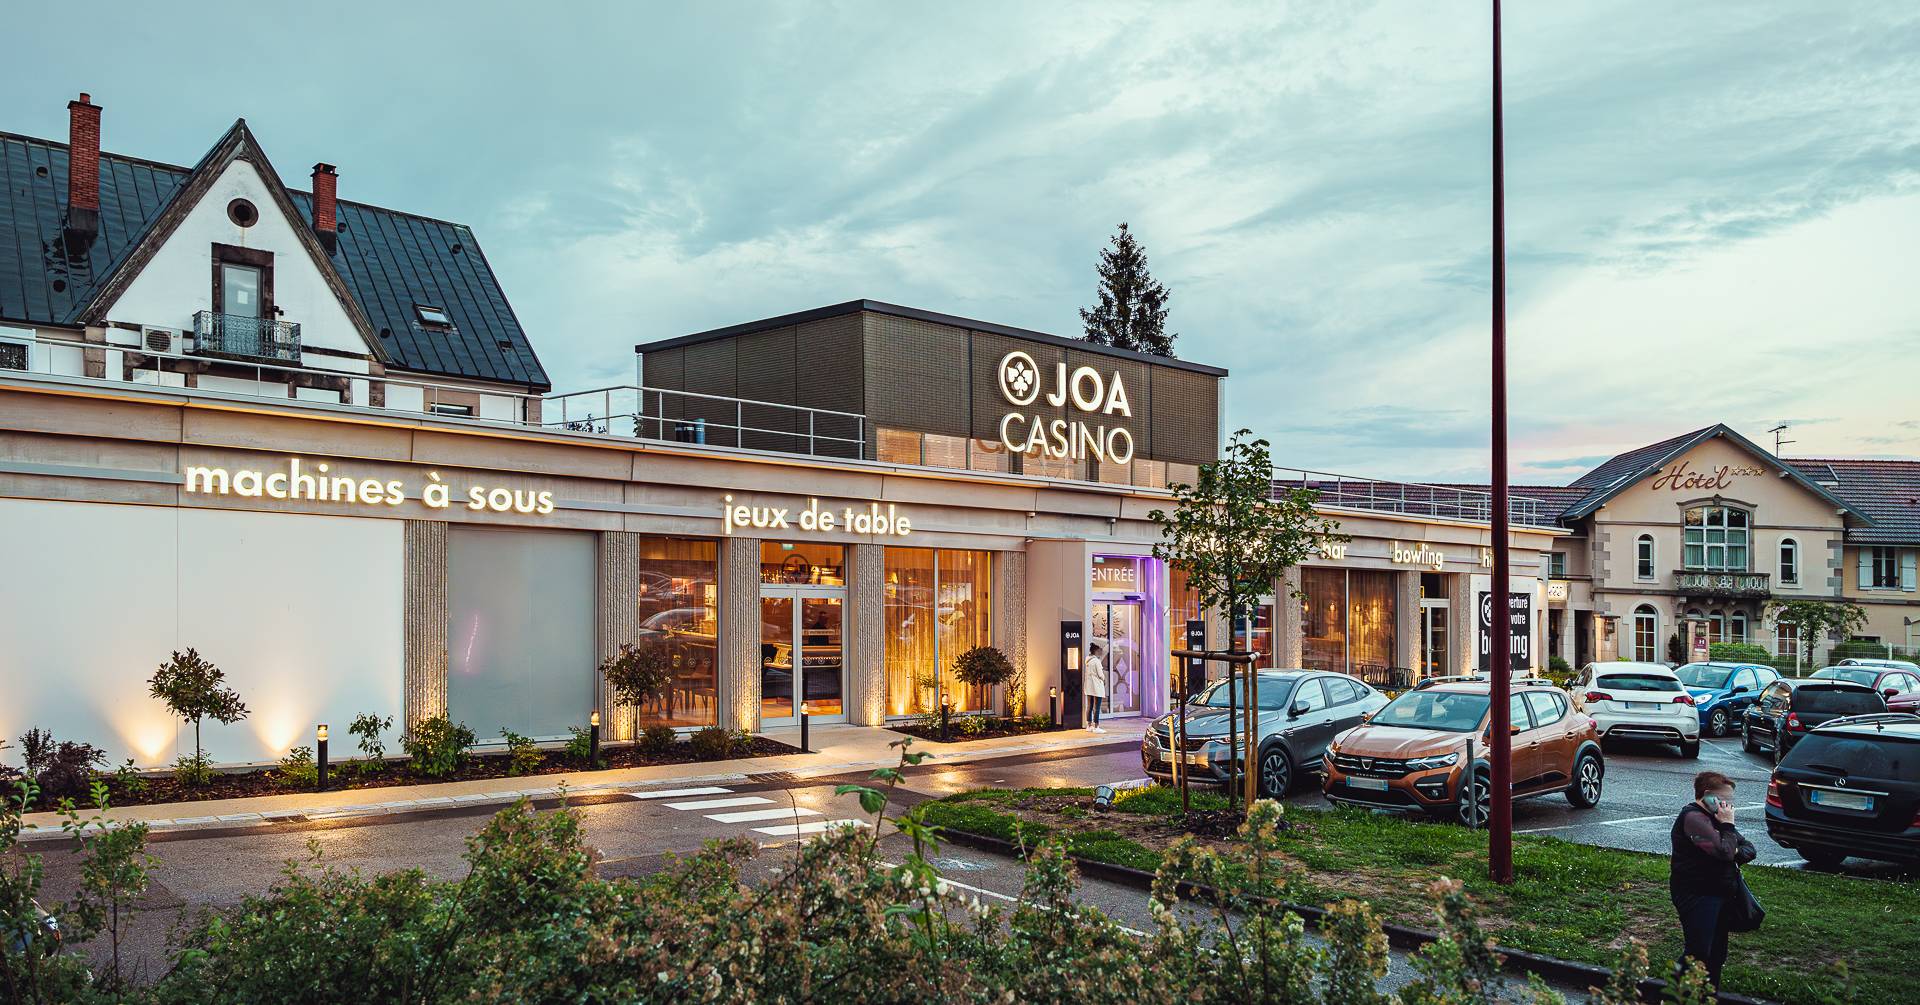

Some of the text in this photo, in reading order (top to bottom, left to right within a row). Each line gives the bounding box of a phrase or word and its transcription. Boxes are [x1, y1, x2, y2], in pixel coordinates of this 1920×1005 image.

[1046, 362, 1131, 417] JOA
[1000, 412, 1134, 465] CASINO
[185, 458, 554, 514] machines à sous
[1652, 461, 1732, 491] Hôtel
[725, 494, 912, 536] jeux de table
[1322, 535, 1347, 559] bar
[1394, 541, 1444, 570] bowling
[1510, 612, 1526, 625] votre
[1481, 629, 1528, 659] bing
